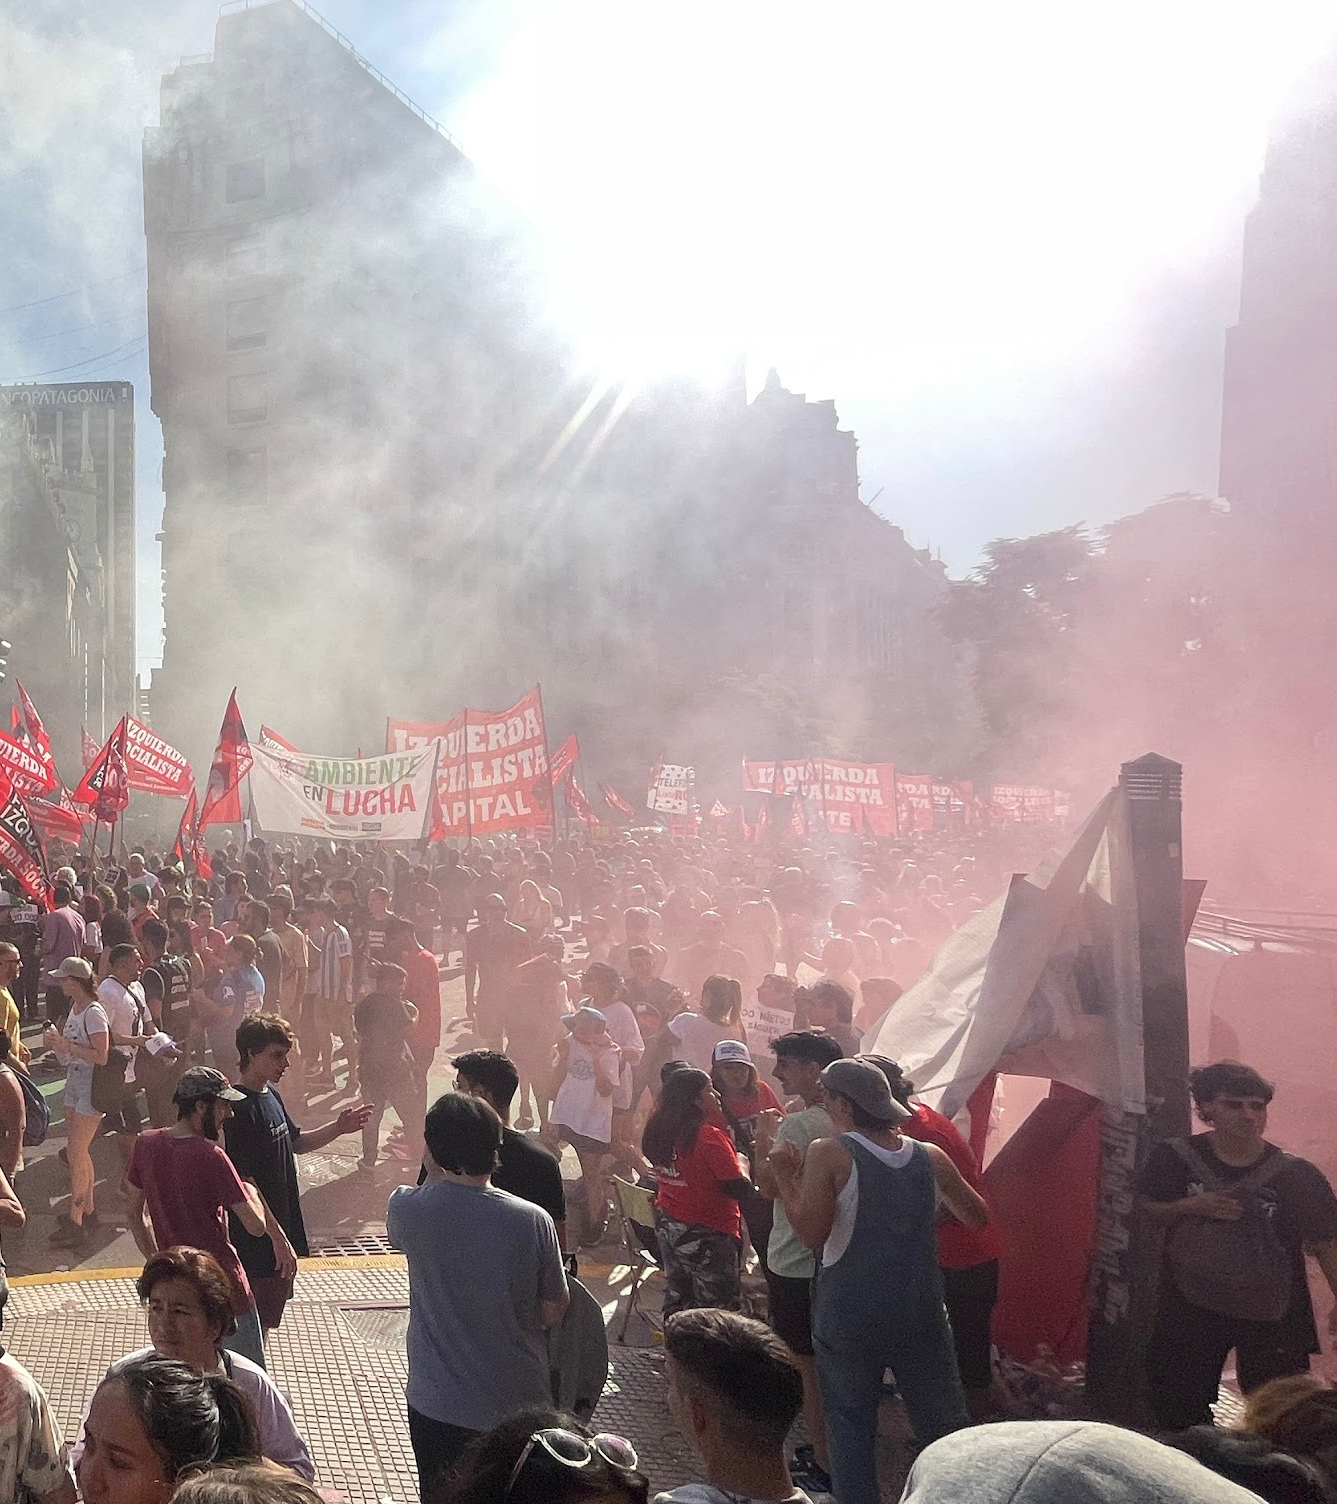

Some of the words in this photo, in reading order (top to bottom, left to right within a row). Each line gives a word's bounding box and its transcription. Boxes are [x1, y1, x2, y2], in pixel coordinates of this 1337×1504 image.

[126, 718, 188, 768] IZQUIERDA
[126, 740, 183, 783] OCIALISTA
[306, 755, 416, 786] AMBIENTE
[435, 744, 548, 796] CIALISTA
[303, 784, 323, 802] EN
[325, 783, 417, 817] LUCHA
[440, 789, 532, 826] APITAL
